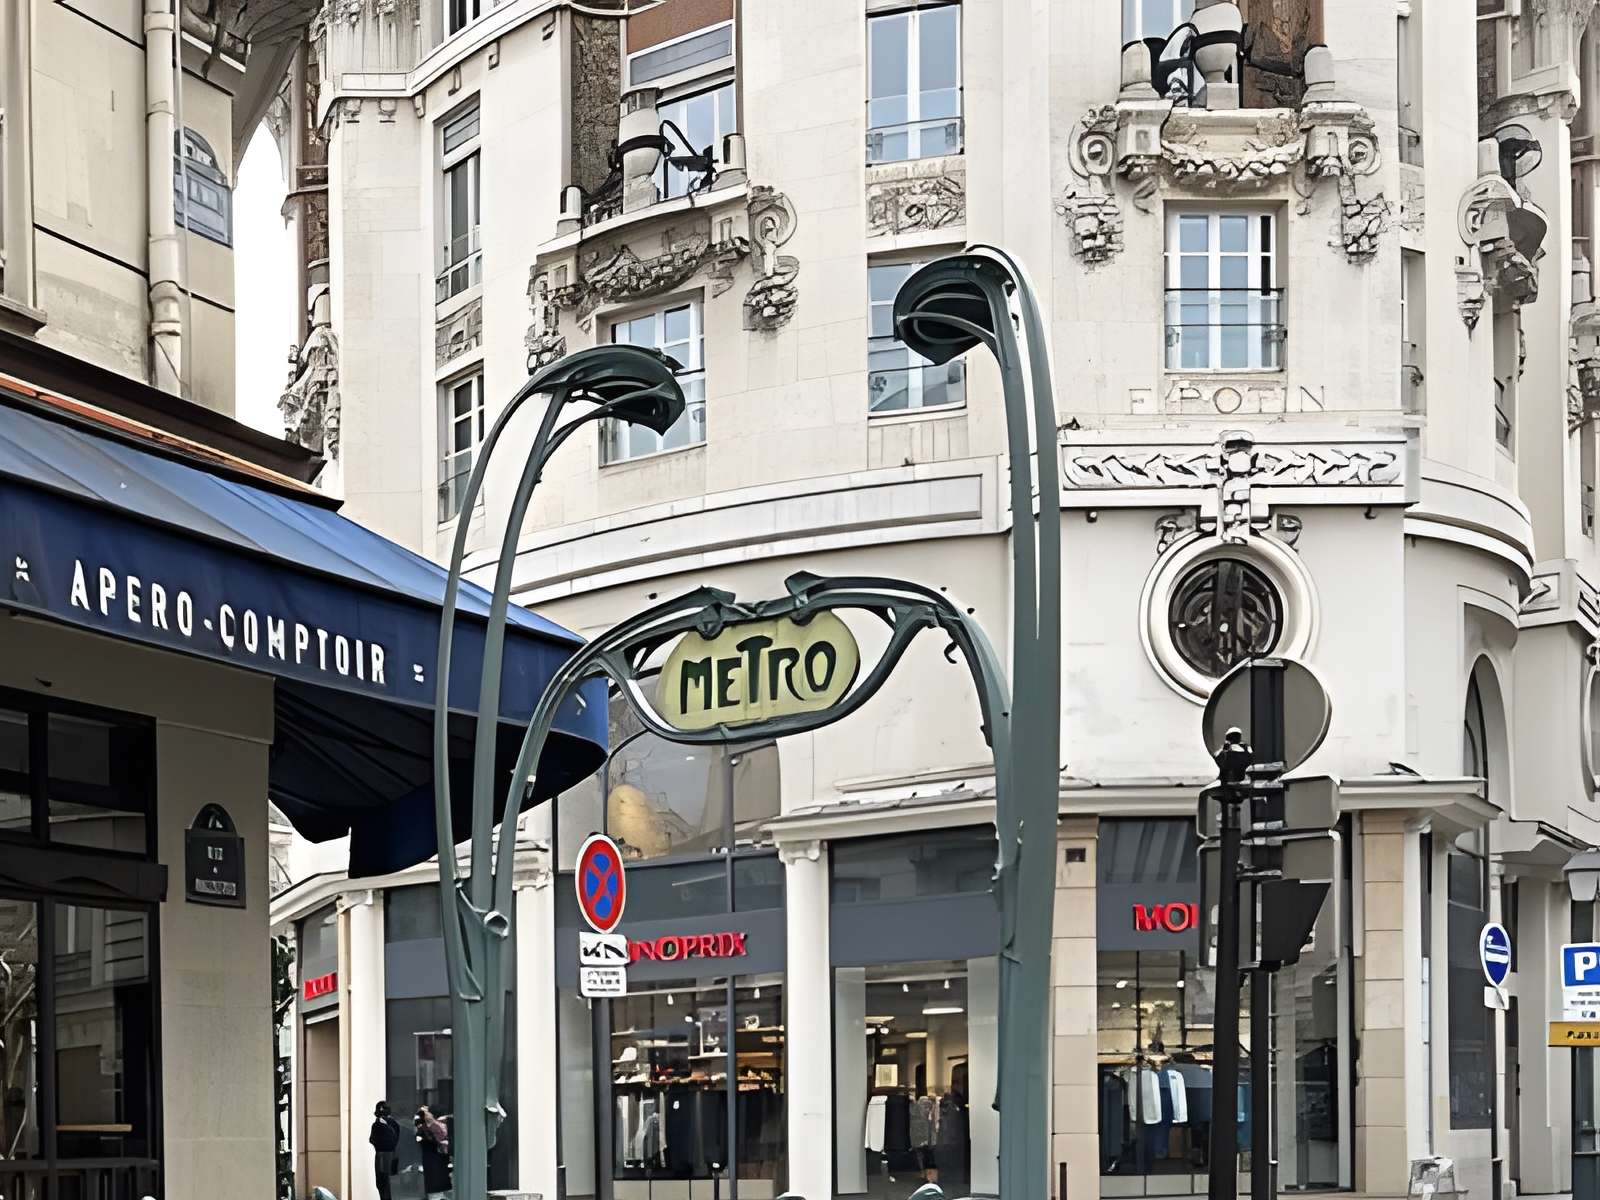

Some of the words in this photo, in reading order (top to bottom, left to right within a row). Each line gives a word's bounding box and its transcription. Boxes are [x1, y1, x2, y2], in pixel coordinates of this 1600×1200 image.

[70, 558, 386, 685] APERO-COMPTOIR
[679, 634, 837, 715] METRO
[627, 931, 749, 962] NOPRIX
